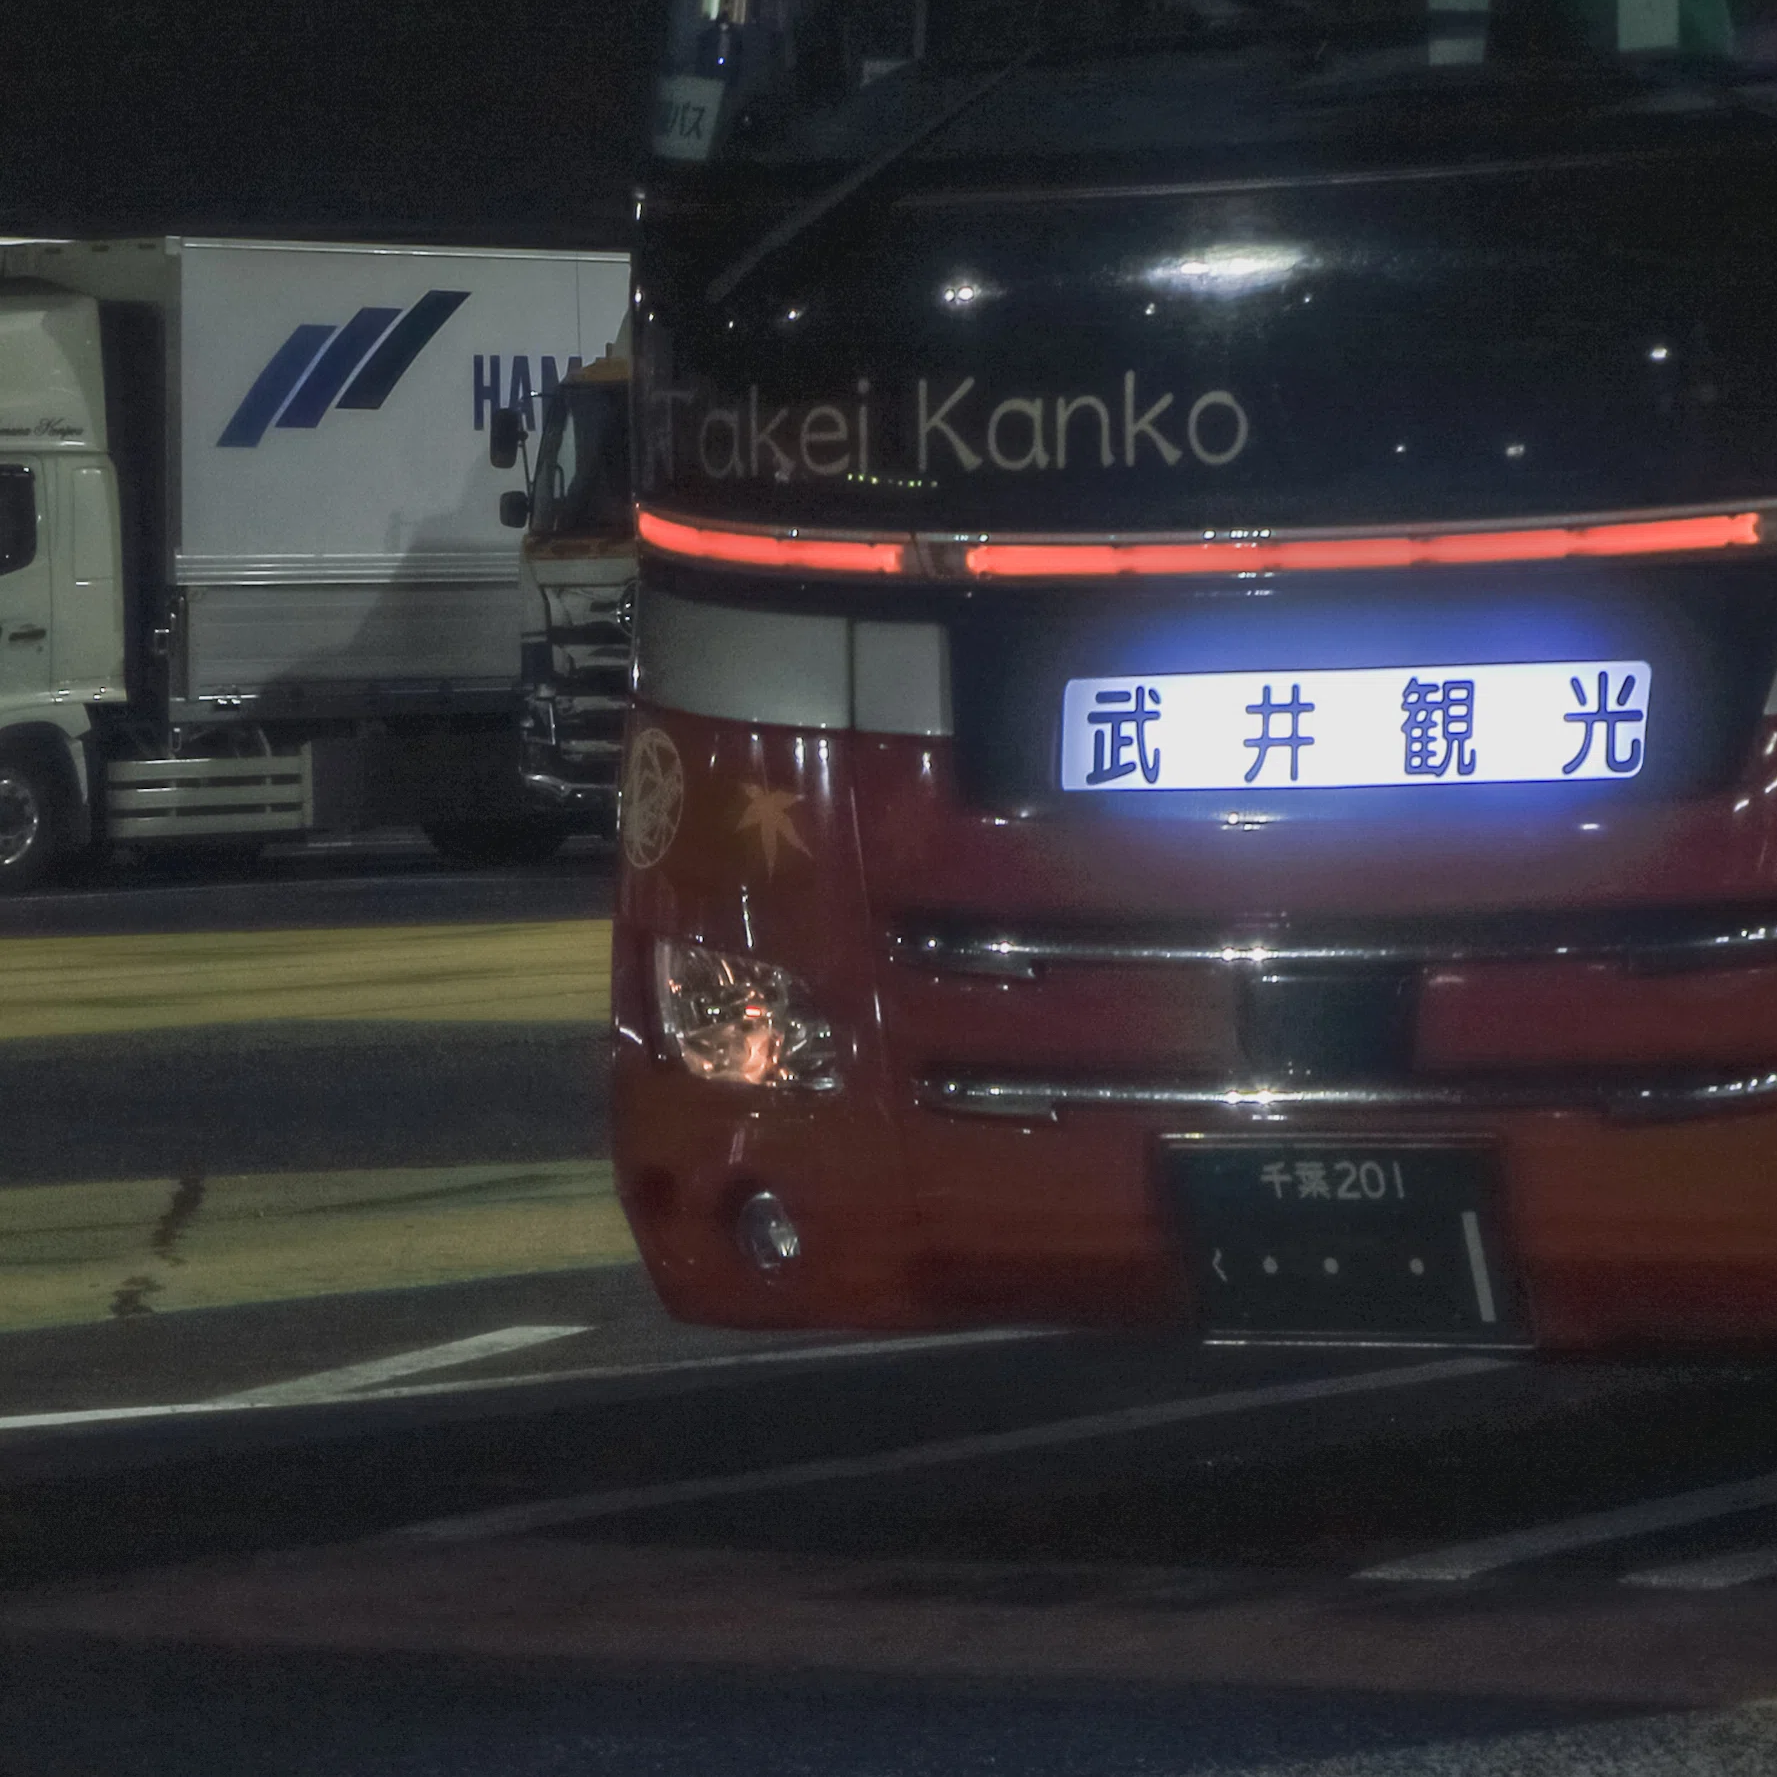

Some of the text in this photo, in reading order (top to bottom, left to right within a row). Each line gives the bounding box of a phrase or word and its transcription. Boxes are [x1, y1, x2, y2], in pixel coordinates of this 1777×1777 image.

[648, 369, 1249, 481] Takei Kanko
[1085, 670, 1644, 785] 武井観光
